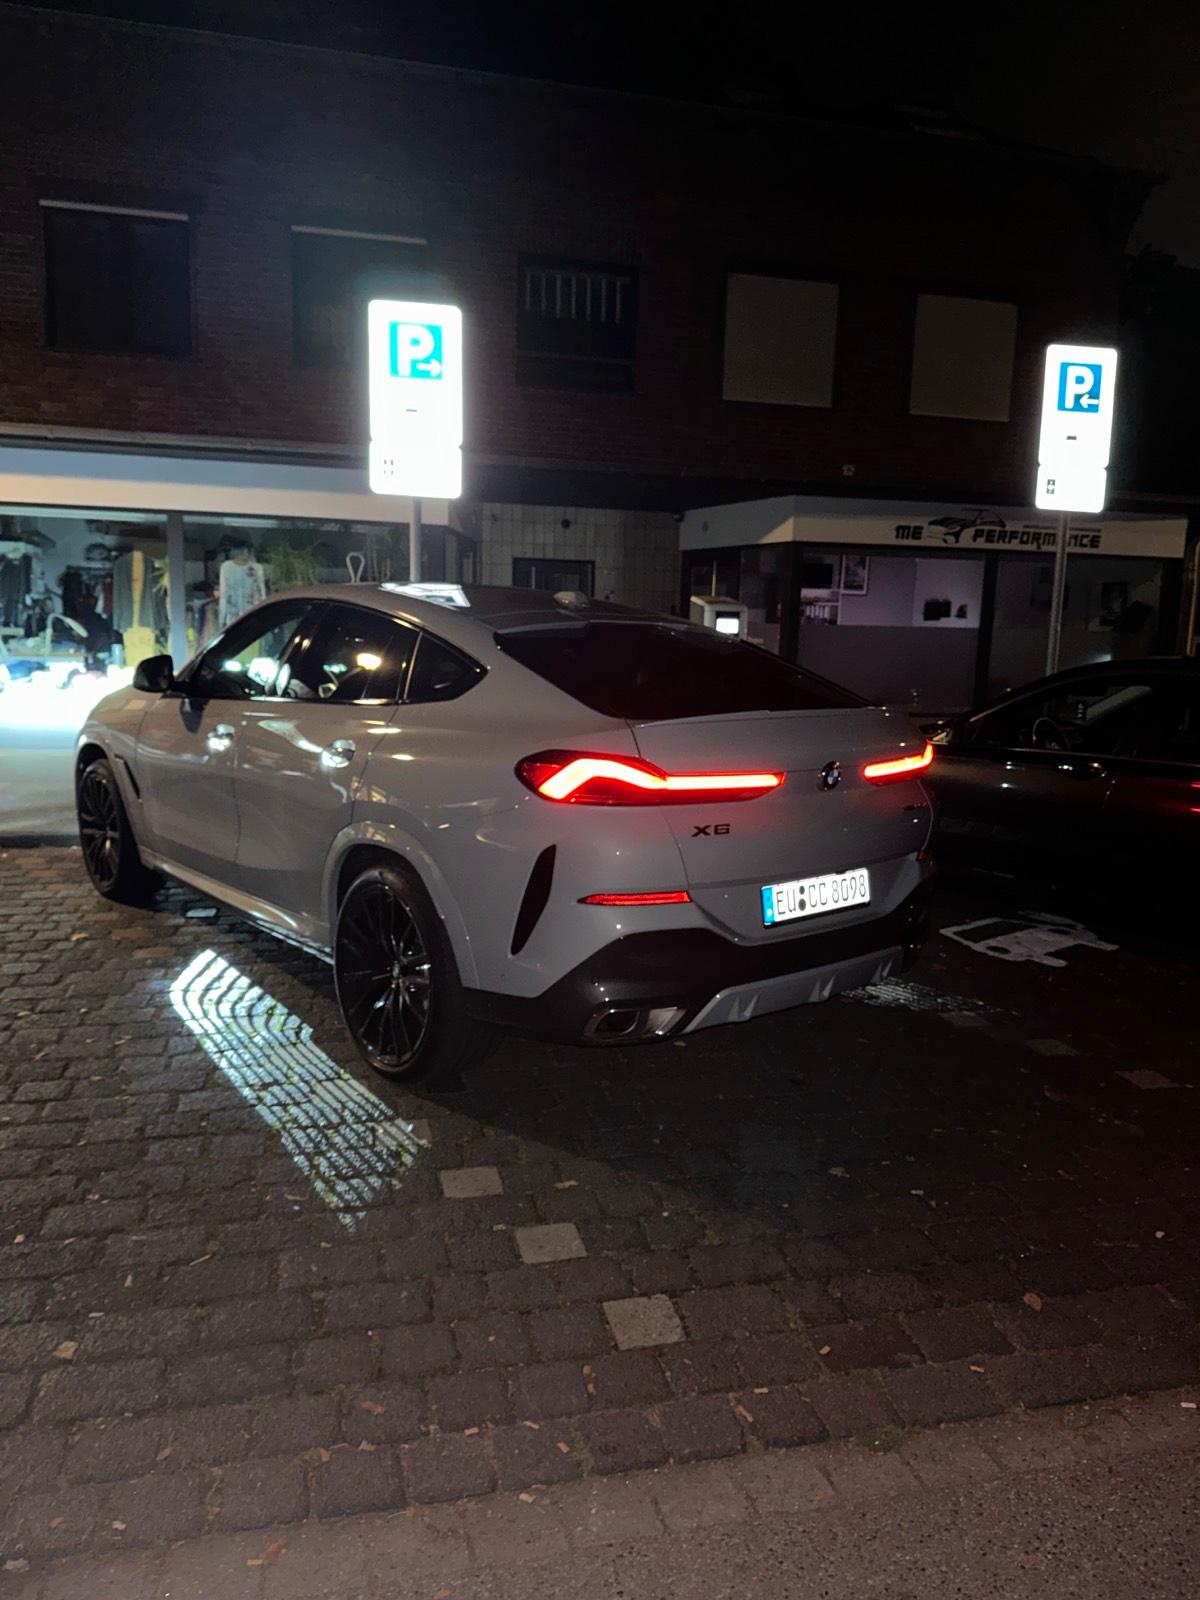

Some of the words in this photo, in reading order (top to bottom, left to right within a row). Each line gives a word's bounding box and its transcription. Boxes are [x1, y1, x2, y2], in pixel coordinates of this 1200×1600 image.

[398, 324, 435, 377] P
[1065, 365, 1094, 409] P
[895, 524, 924, 540] ME
[973, 528, 1102, 549] PERFORMNCE
[691, 823, 731, 838] X6
[776, 888, 797, 915] EU
[808, 882, 828, 908] CC
[832, 874, 866, 903] 8098
